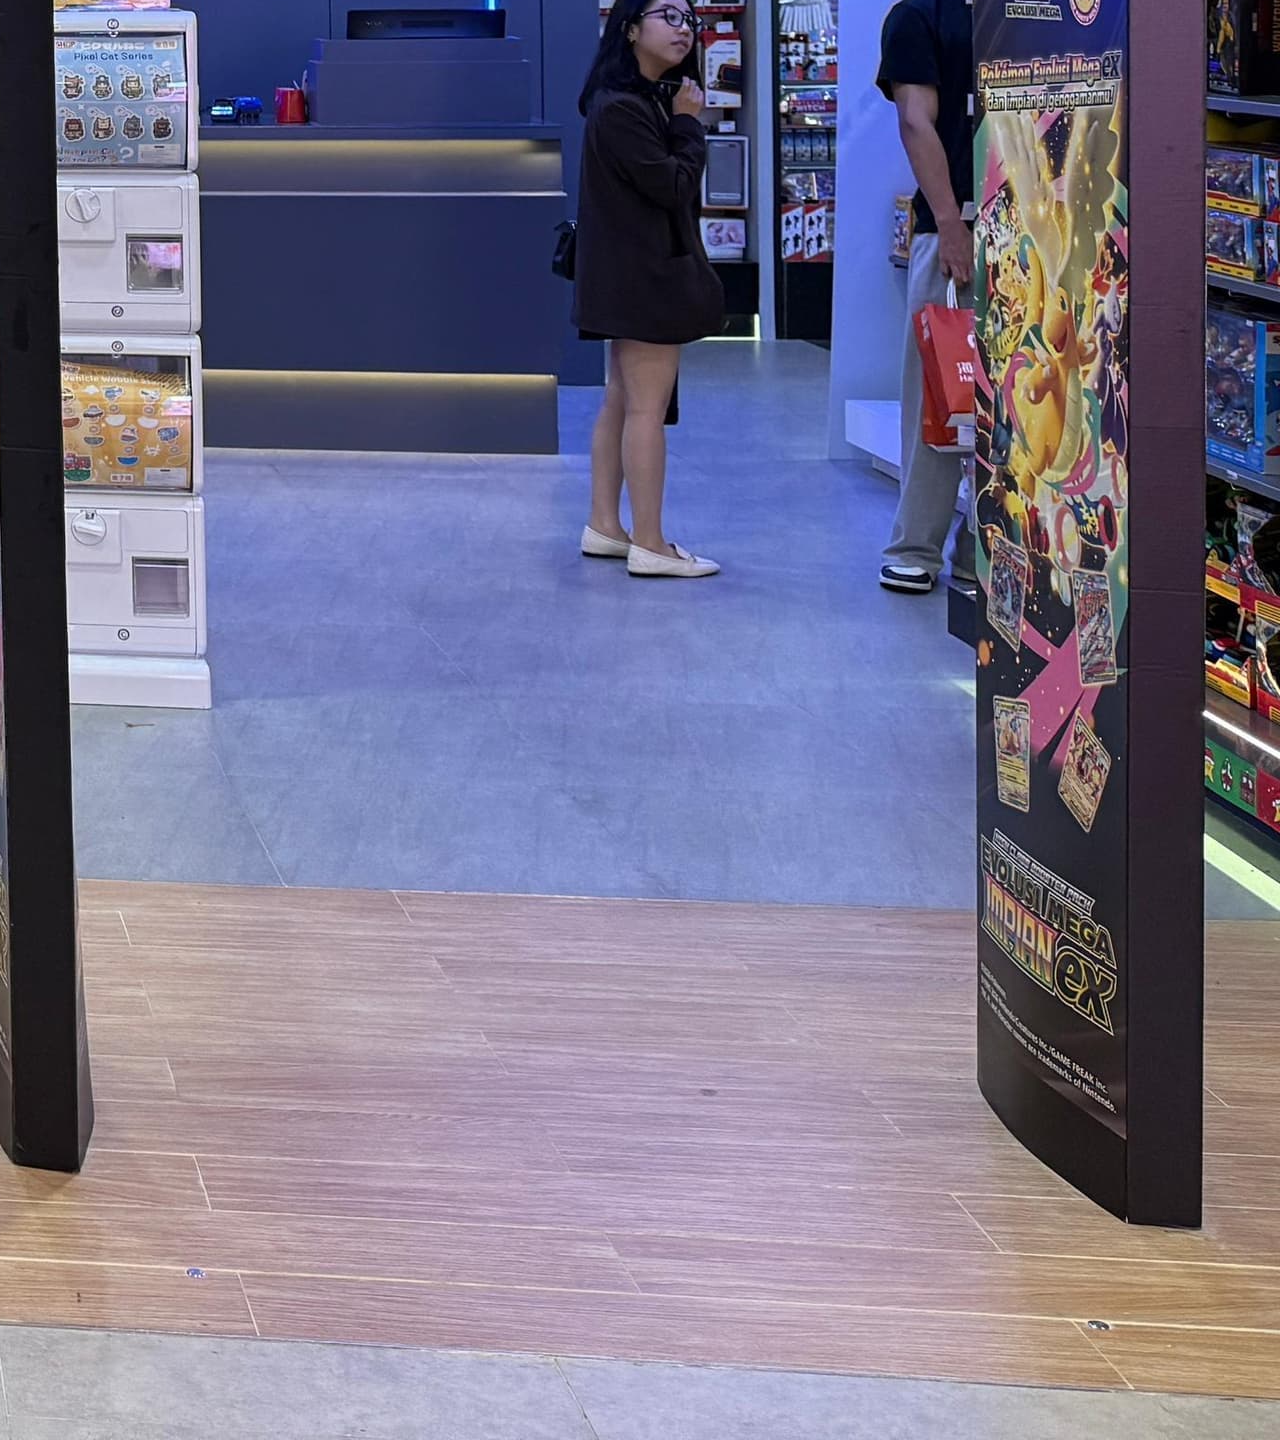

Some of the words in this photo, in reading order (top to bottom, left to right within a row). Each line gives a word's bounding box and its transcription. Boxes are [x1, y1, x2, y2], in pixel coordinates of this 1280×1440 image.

[74, 51, 98, 61] Pixel
[100, 52, 119, 61] Cat
[121, 52, 154, 61] Series
[980, 60, 1032, 87] Pokémon
[1033, 56, 1070, 86] Evolusi
[1072, 54, 1101, 86] Mega
[1103, 52, 1122, 79] ex
[987, 92, 1005, 110] dan
[1006, 90, 1037, 113] impian
[1048, 86, 1114, 112] genggamanmu!
[982, 842, 1043, 917] EVOLUSI
[1046, 892, 1116, 968] MEGA
[986, 875, 1056, 988] IMPIAN
[1055, 948, 1117, 1027] ex
[1072, 1062, 1095, 1084] FREAK
[1082, 1082, 1117, 1114] Nintendo.
